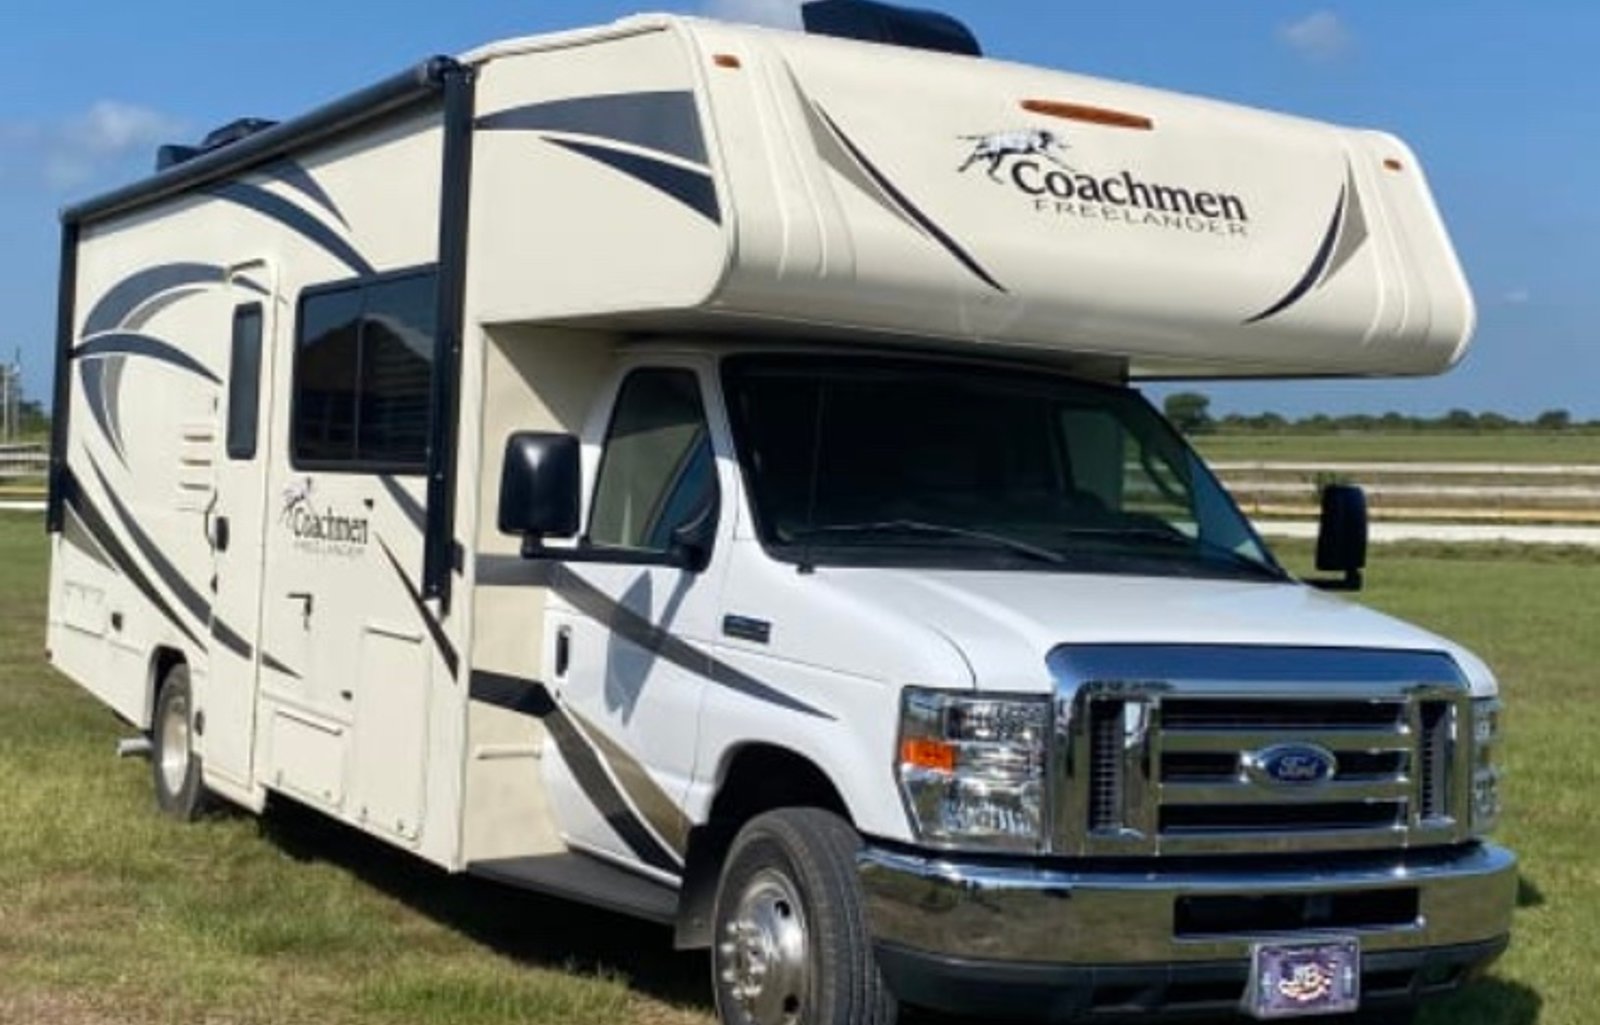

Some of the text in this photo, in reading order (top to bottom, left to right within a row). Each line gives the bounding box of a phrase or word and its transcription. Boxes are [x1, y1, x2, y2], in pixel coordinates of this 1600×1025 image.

[1011, 160, 1248, 221] Coachmen
[1033, 199, 1248, 236] FREELANDER
[294, 506, 368, 545] Coachmen
[1278, 756, 1318, 777] Ford
